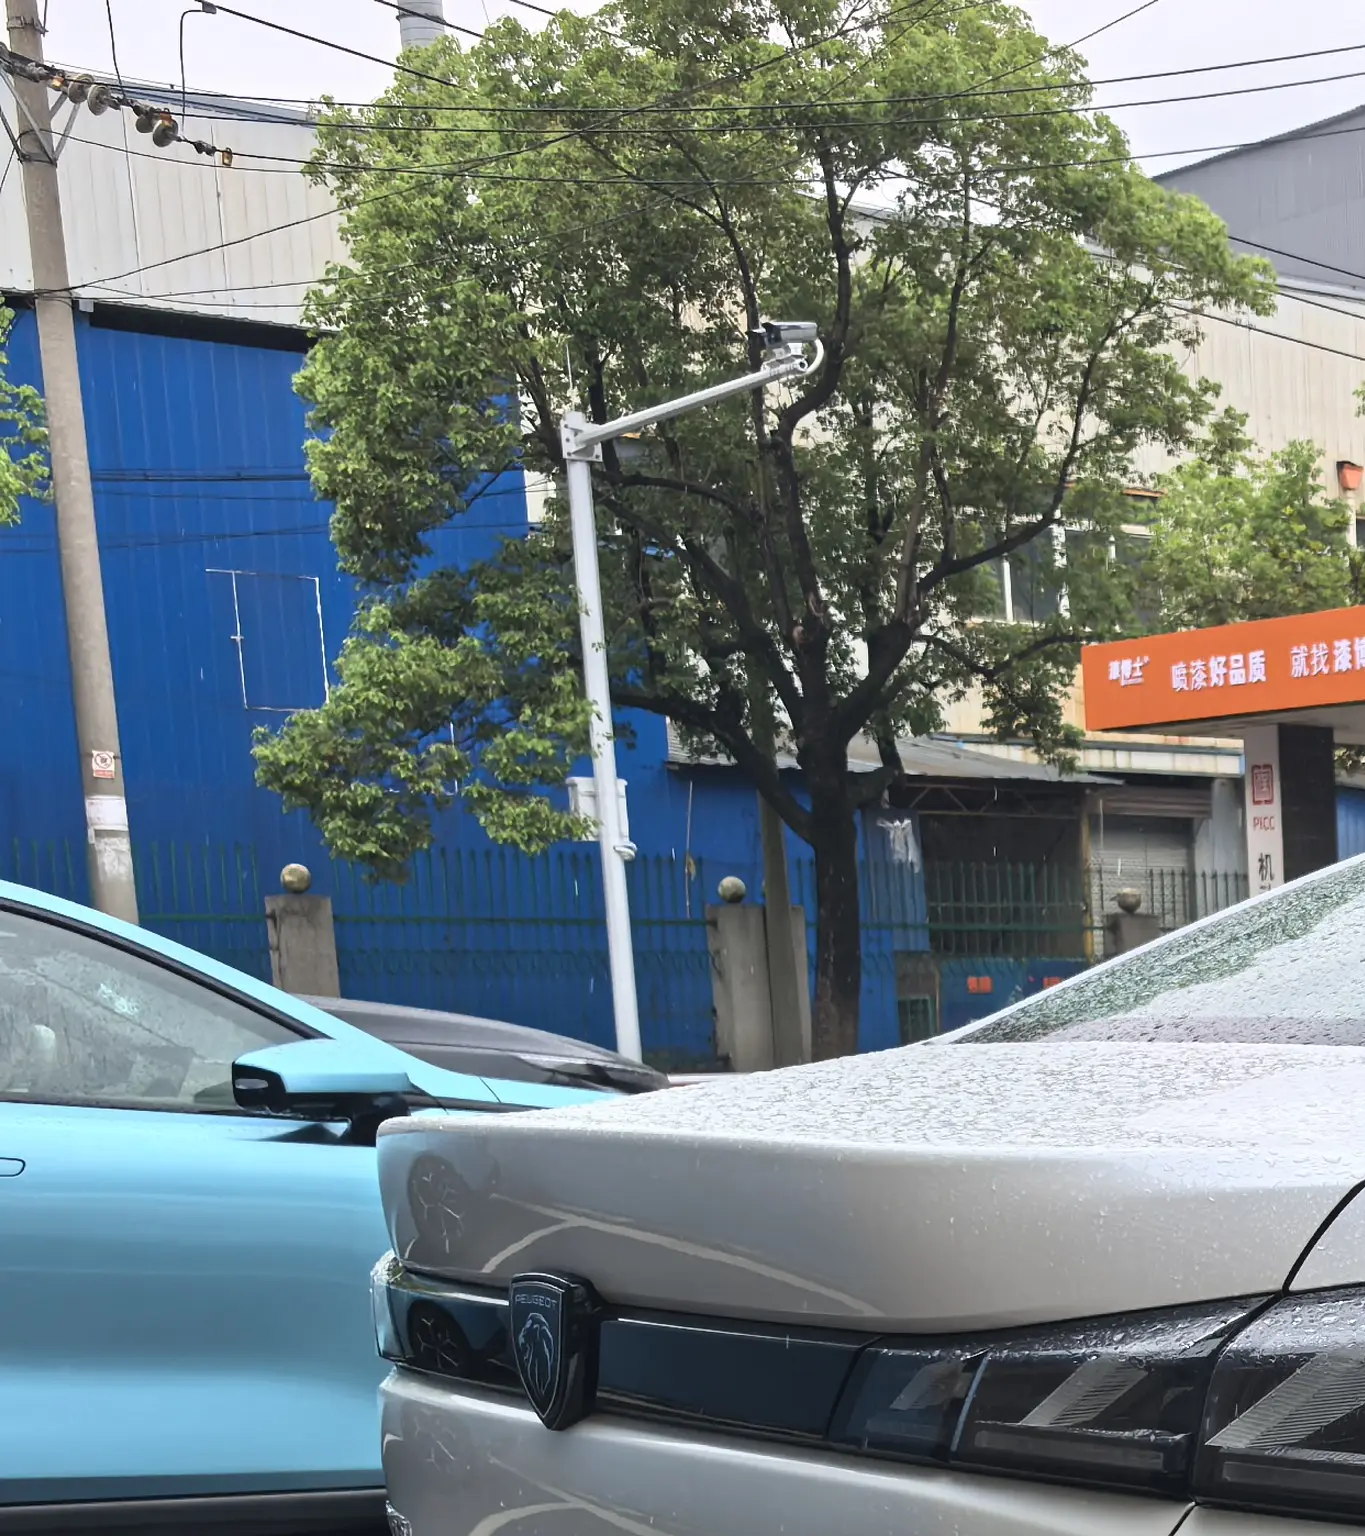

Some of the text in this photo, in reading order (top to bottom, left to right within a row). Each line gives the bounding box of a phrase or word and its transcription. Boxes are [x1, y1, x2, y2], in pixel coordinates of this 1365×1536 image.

[1171, 649, 1267, 692] 喷漆好品质
[1252, 815, 1276, 831] PICC
[514, 1293, 558, 1310] PEUGEOT
